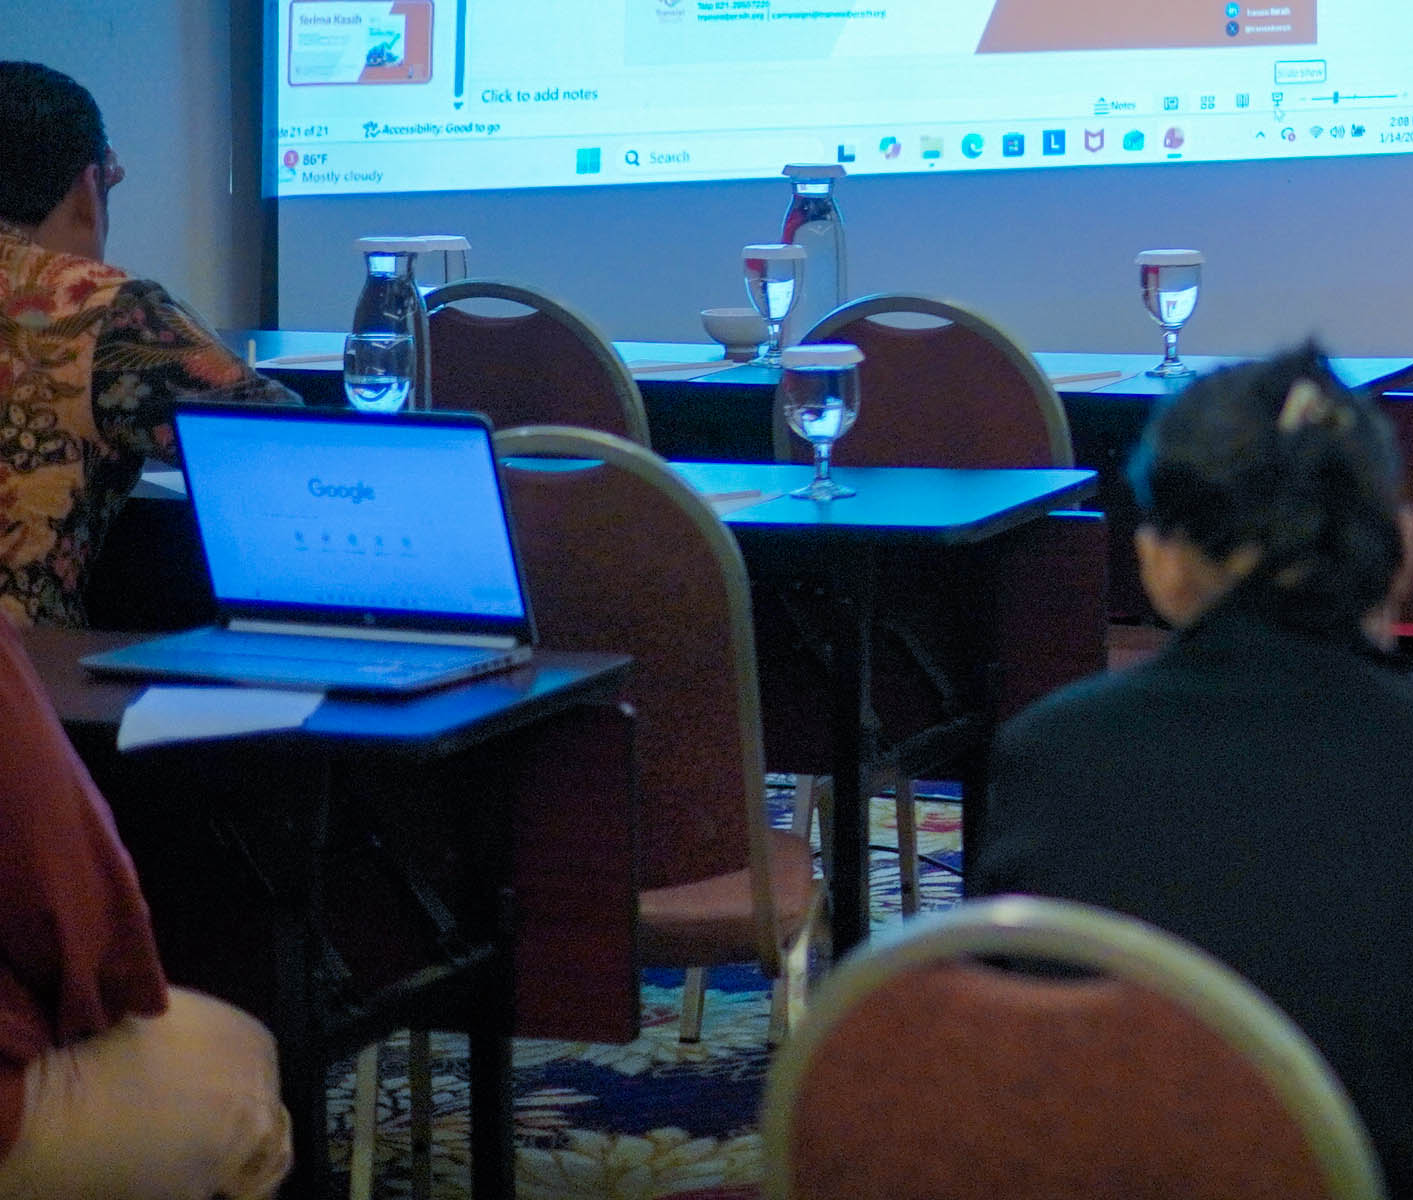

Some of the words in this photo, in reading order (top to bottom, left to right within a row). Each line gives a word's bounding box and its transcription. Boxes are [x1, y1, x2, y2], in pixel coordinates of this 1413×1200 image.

[481, 89, 512, 104] Click
[516, 90, 531, 103] to
[533, 89, 559, 103] add
[562, 87, 598, 102] notes
[445, 121, 473, 135] Good
[475, 122, 485, 134] to
[487, 123, 501, 136] go
[649, 149, 690, 165] Search
[302, 170, 340, 184] Mostly
[343, 169, 384, 185] cloudy
[308, 477, 376, 504] Google
